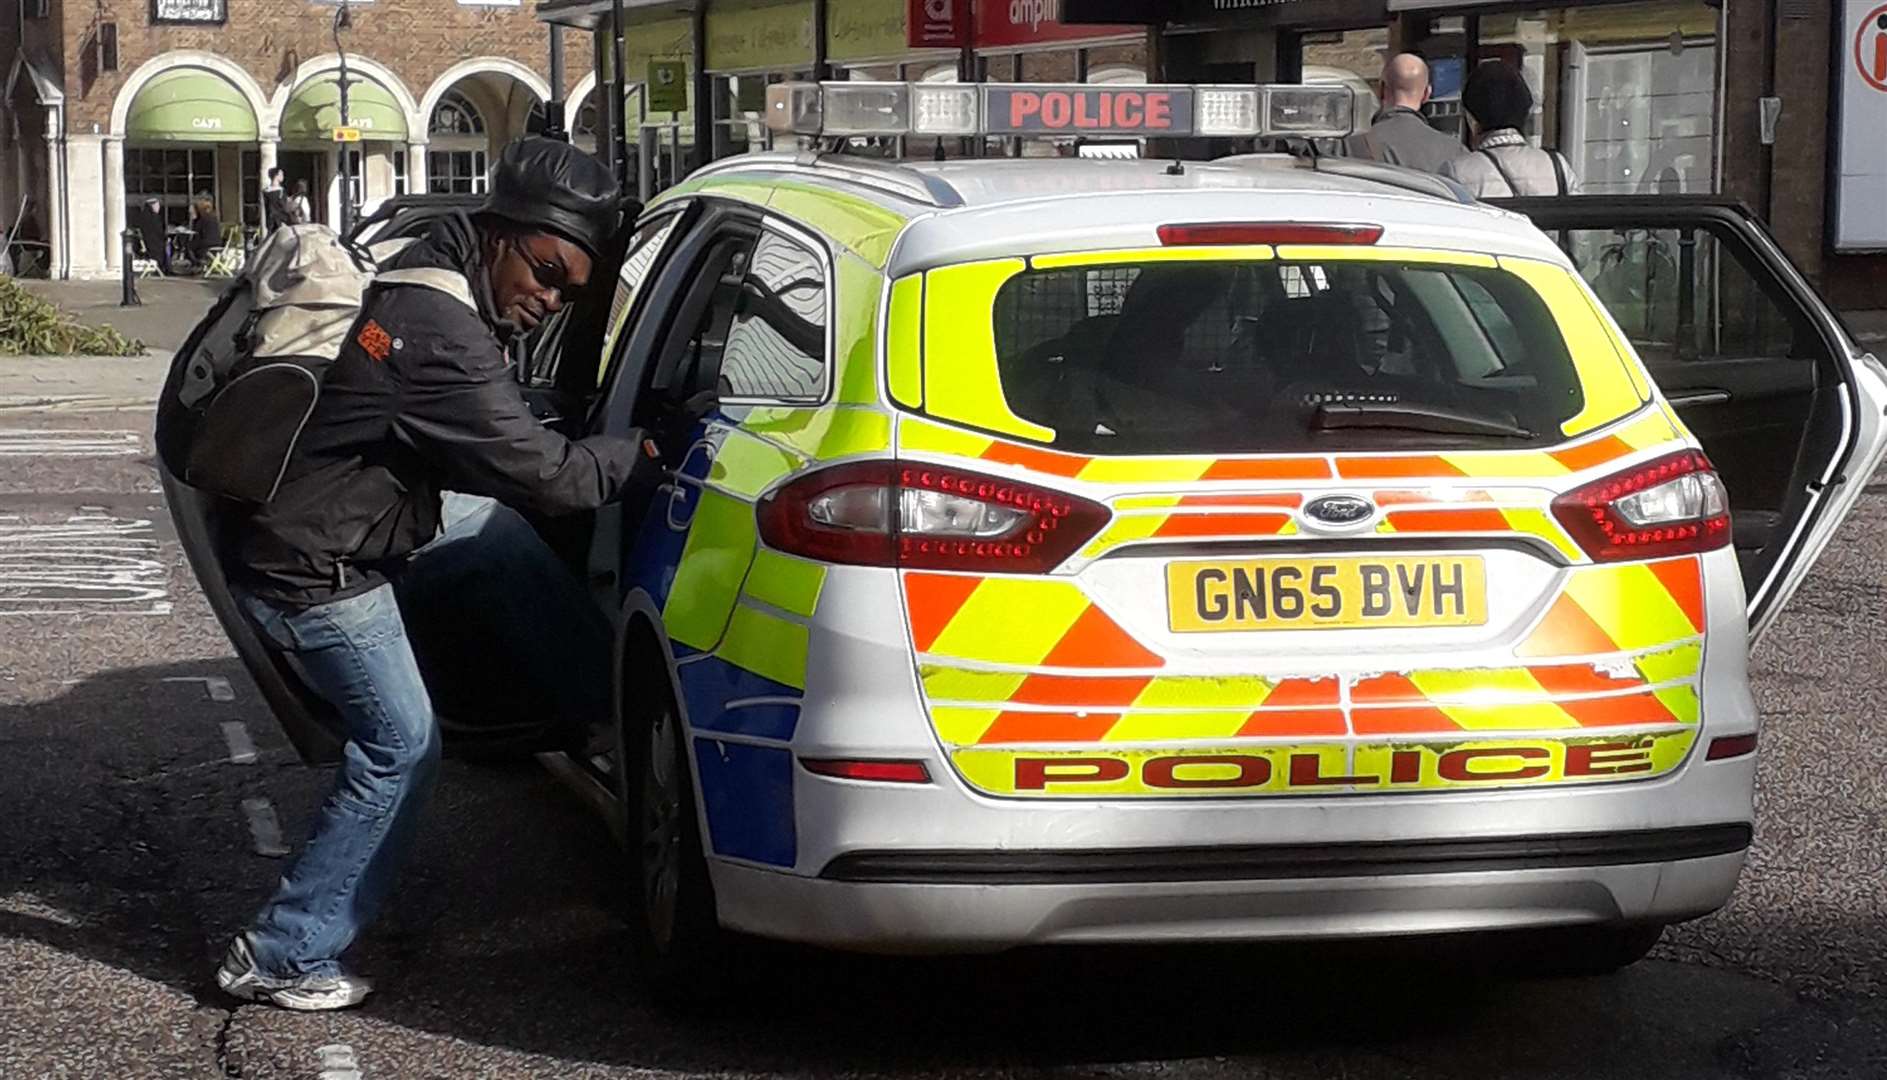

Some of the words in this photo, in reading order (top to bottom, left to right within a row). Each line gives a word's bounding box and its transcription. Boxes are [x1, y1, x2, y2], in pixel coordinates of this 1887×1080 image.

[1010, 91, 1171, 128] POLICE
[1196, 566, 1342, 621] GN65
[1360, 563, 1465, 617] BVH
[1014, 739, 1654, 791] POLICE
